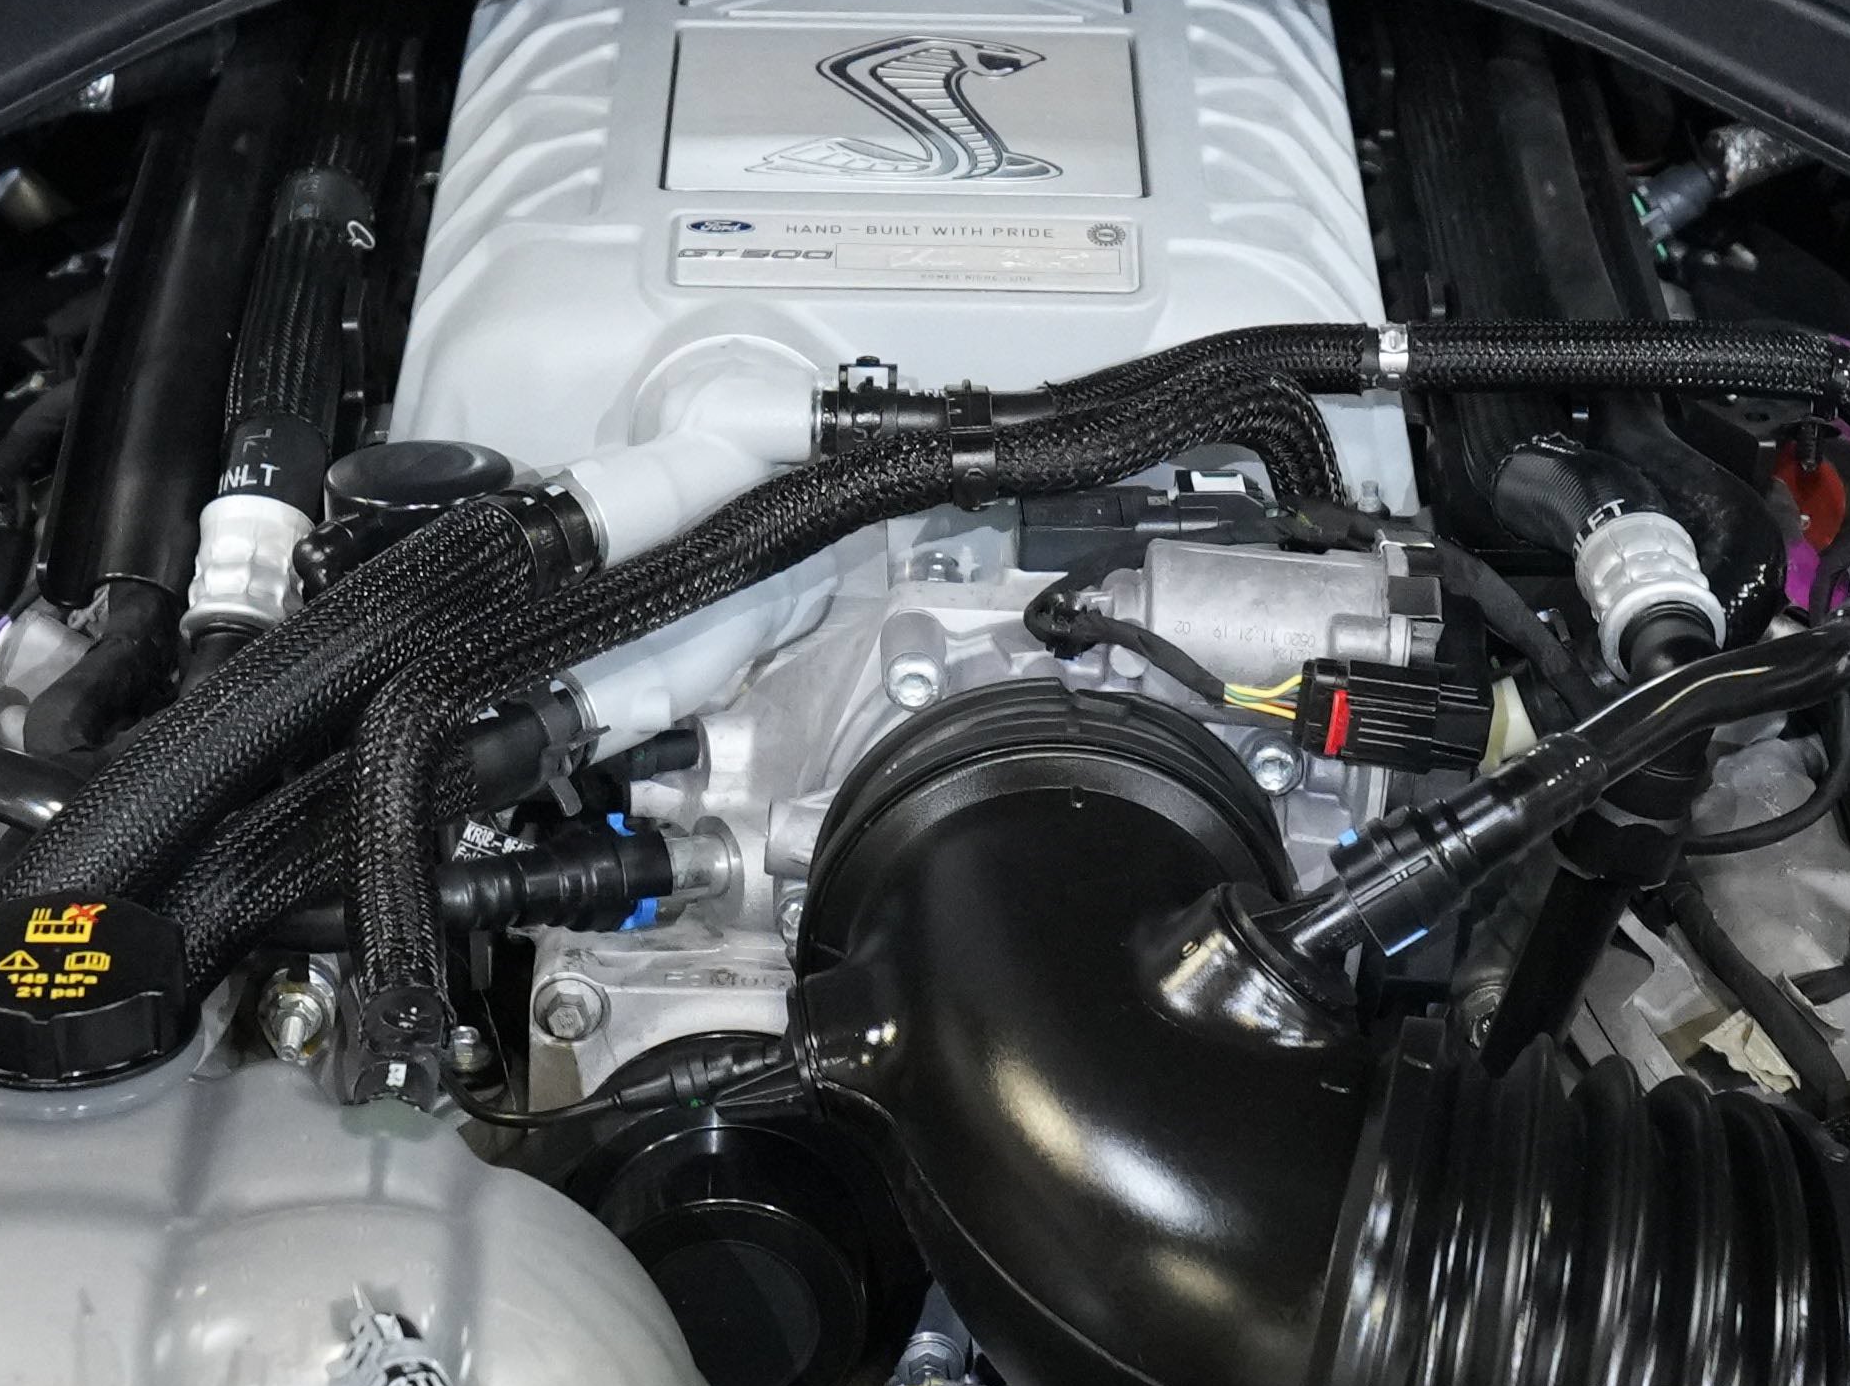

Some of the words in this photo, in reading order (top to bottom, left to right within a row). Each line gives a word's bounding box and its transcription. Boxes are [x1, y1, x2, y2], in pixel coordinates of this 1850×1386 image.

[932, 226, 983, 237] WITH
[992, 227, 1055, 239] PRIDE
[7, 972, 49, 985] 145
[54, 972, 98, 985] kPa
[14, 985, 43, 998] 21
[50, 985, 86, 1000] psi
